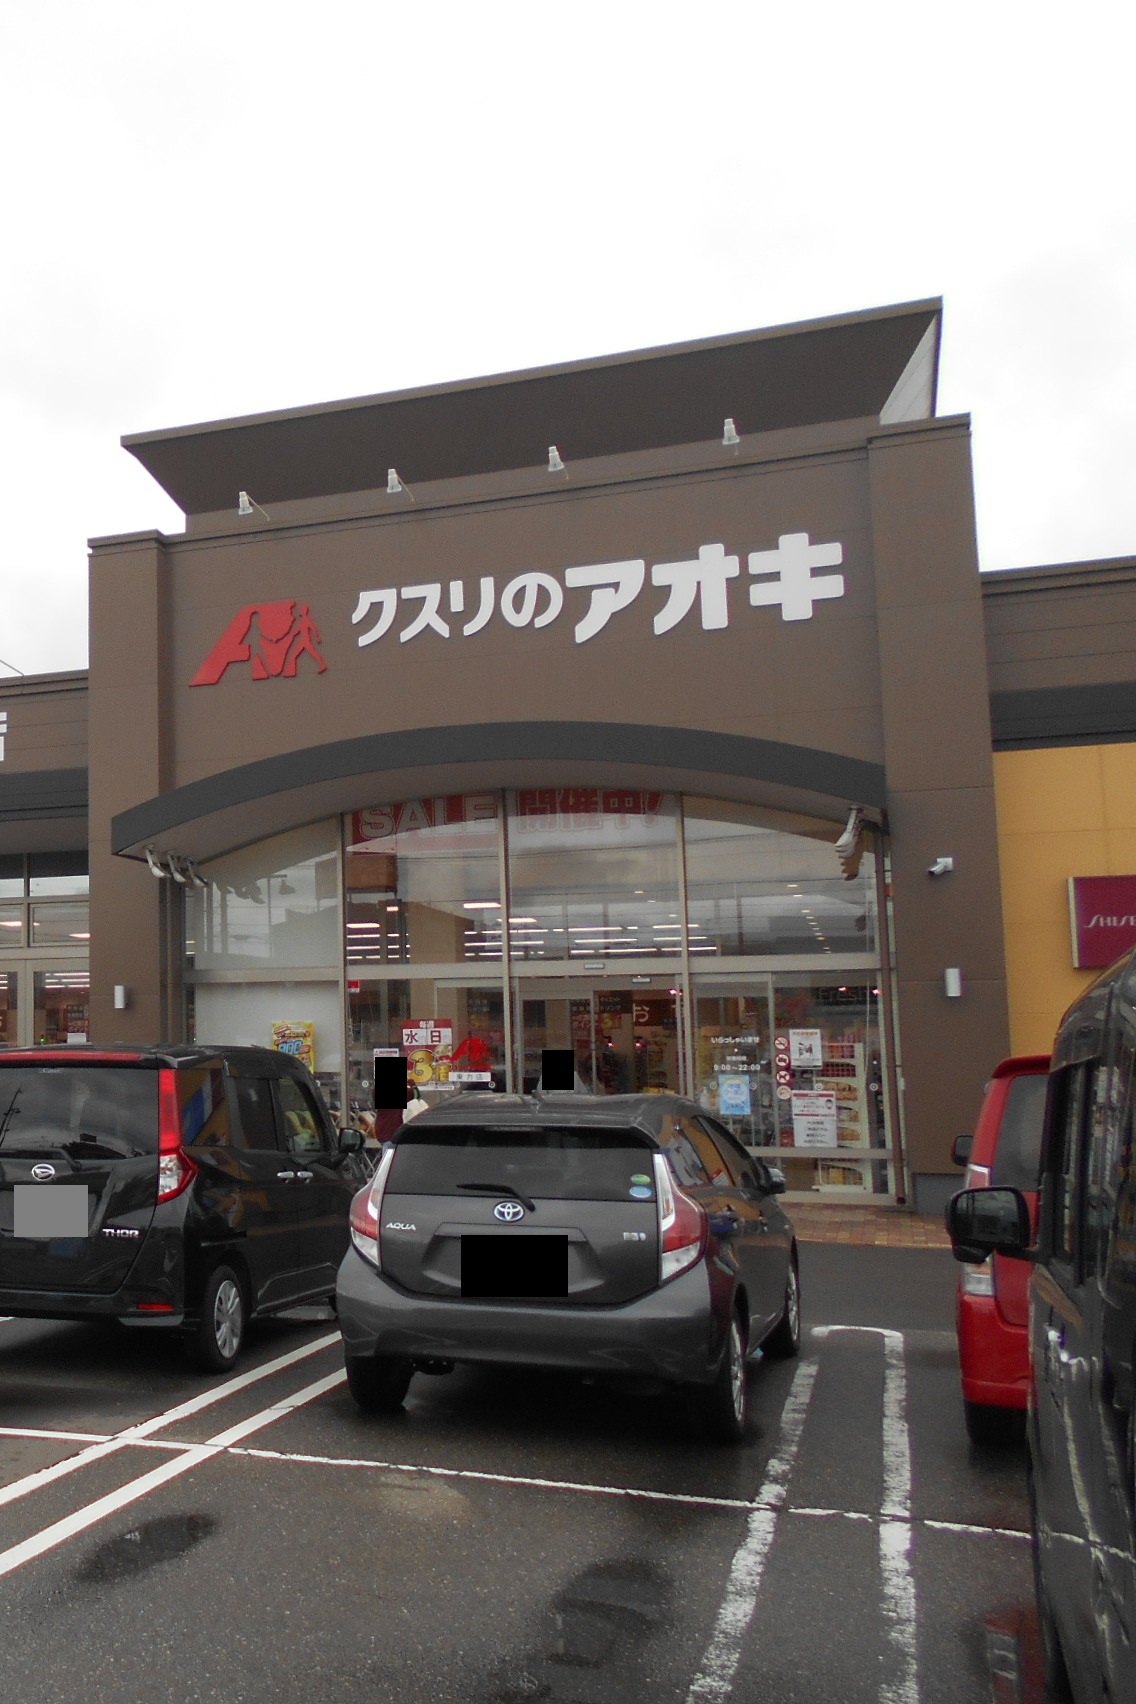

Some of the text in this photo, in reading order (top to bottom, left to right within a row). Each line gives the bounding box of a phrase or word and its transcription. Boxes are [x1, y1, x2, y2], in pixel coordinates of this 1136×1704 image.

[352, 532, 845, 648] クスリのアオキ
[359, 794, 499, 839] SALE
[102, 1227, 140, 1238] THOR
[385, 1222, 417, 1231] AQUA
